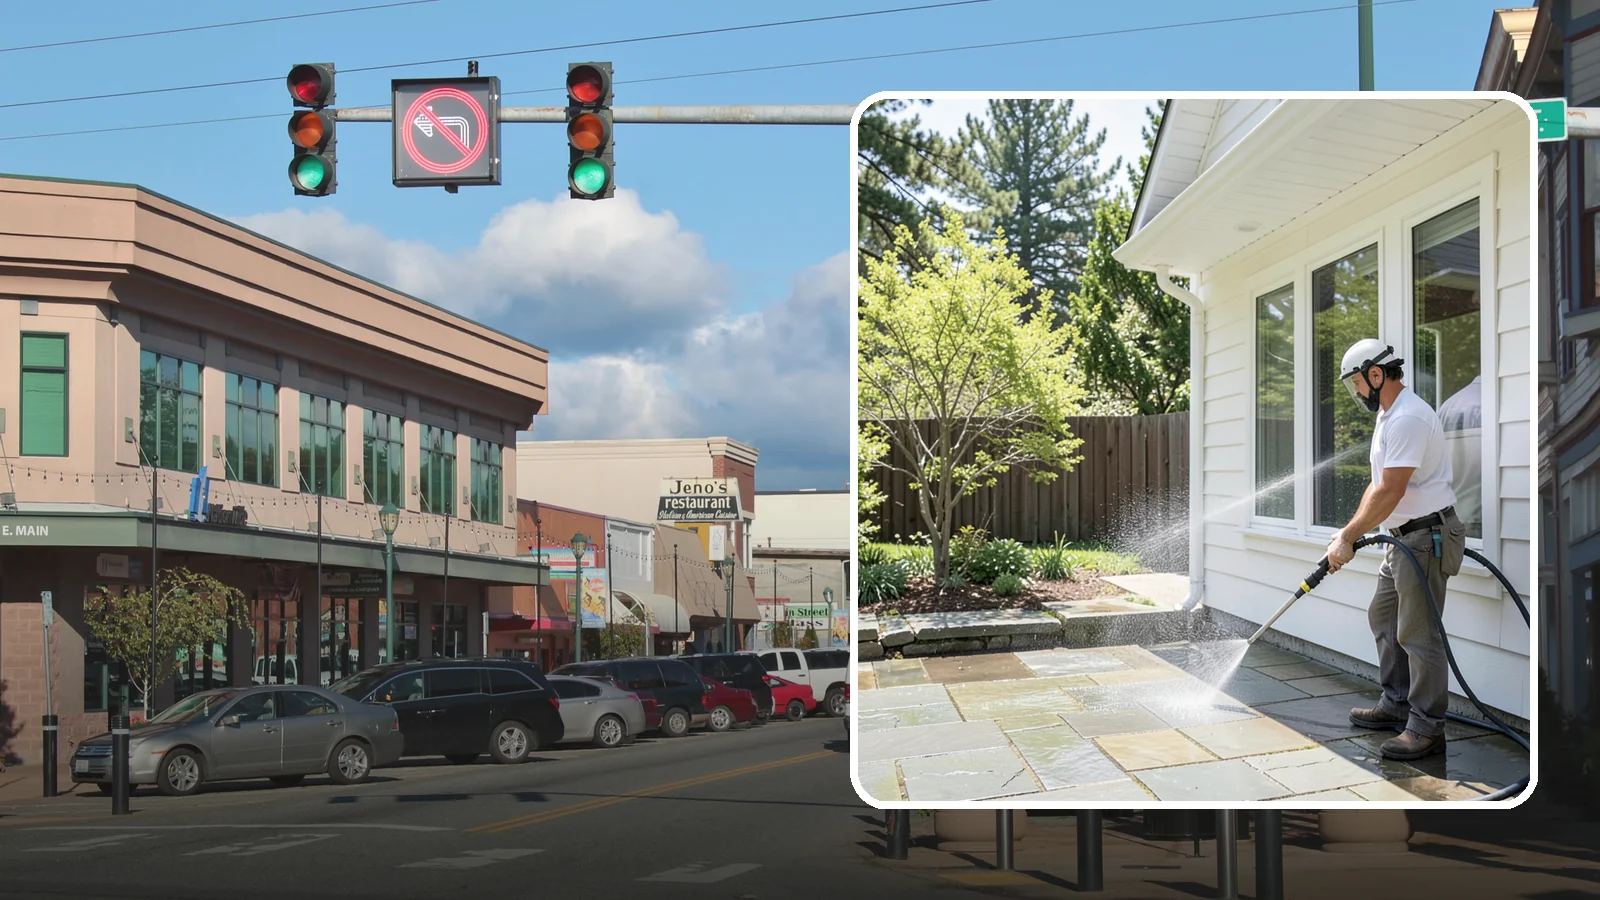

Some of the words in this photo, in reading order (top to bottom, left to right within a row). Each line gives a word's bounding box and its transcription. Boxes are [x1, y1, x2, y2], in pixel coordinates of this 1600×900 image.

[669, 480, 728, 494] Jeno's
[665, 496, 731, 508] restaurant
[659, 510, 681, 519] Italian
[686, 509, 714, 519] American
[715, 509, 737, 519] Cuisine
[2, 525, 13, 536] E.
[15, 525, 49, 536] MAIN
[797, 608, 828, 617] Street
